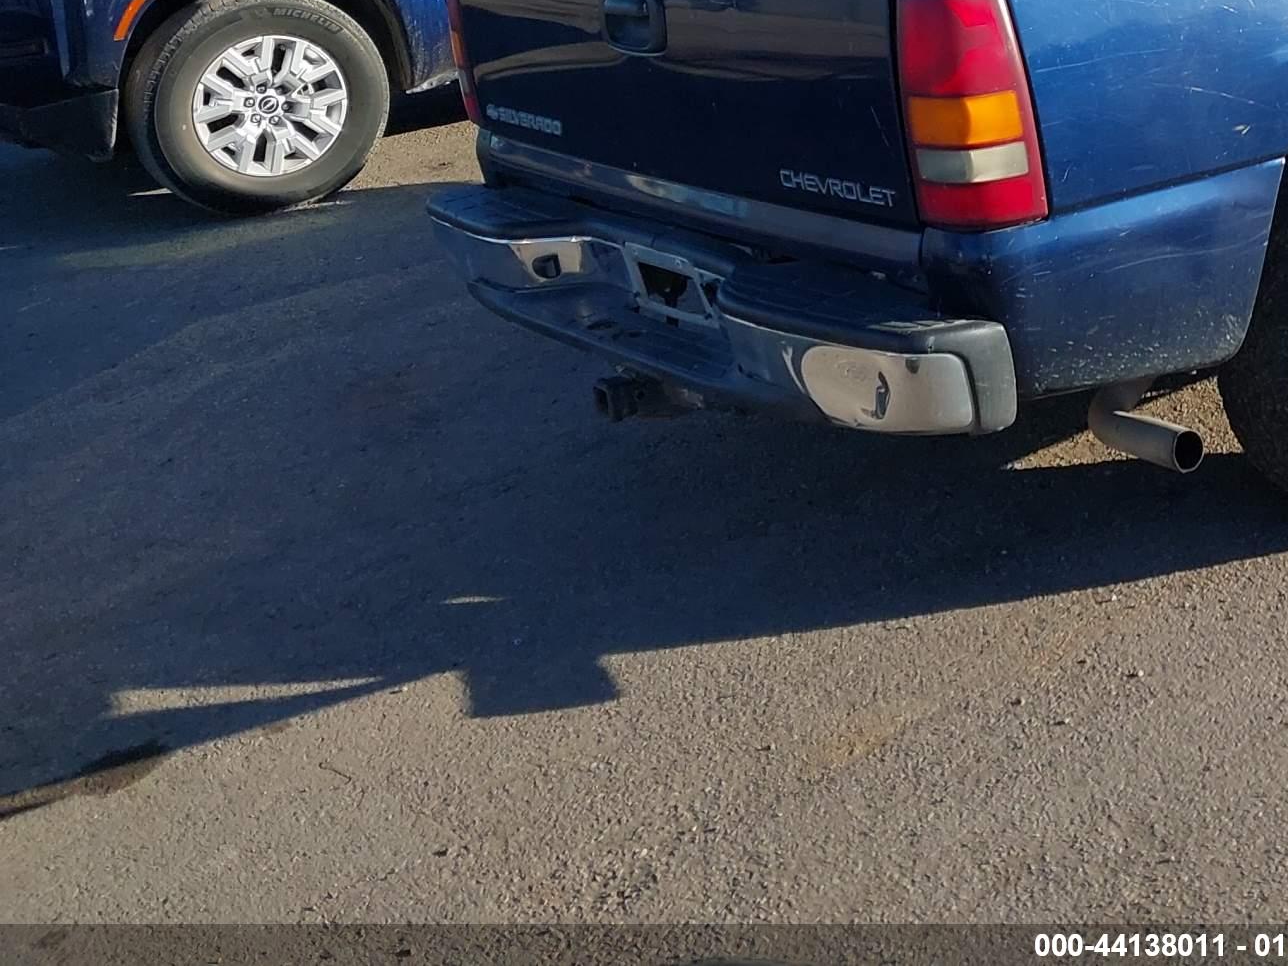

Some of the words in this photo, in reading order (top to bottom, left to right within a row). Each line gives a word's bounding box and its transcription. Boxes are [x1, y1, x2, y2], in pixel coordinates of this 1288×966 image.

[272, 7, 341, 34] MICHELIN
[499, 106, 563, 136] SILVERADO
[779, 168, 896, 207] CHEVROLET
